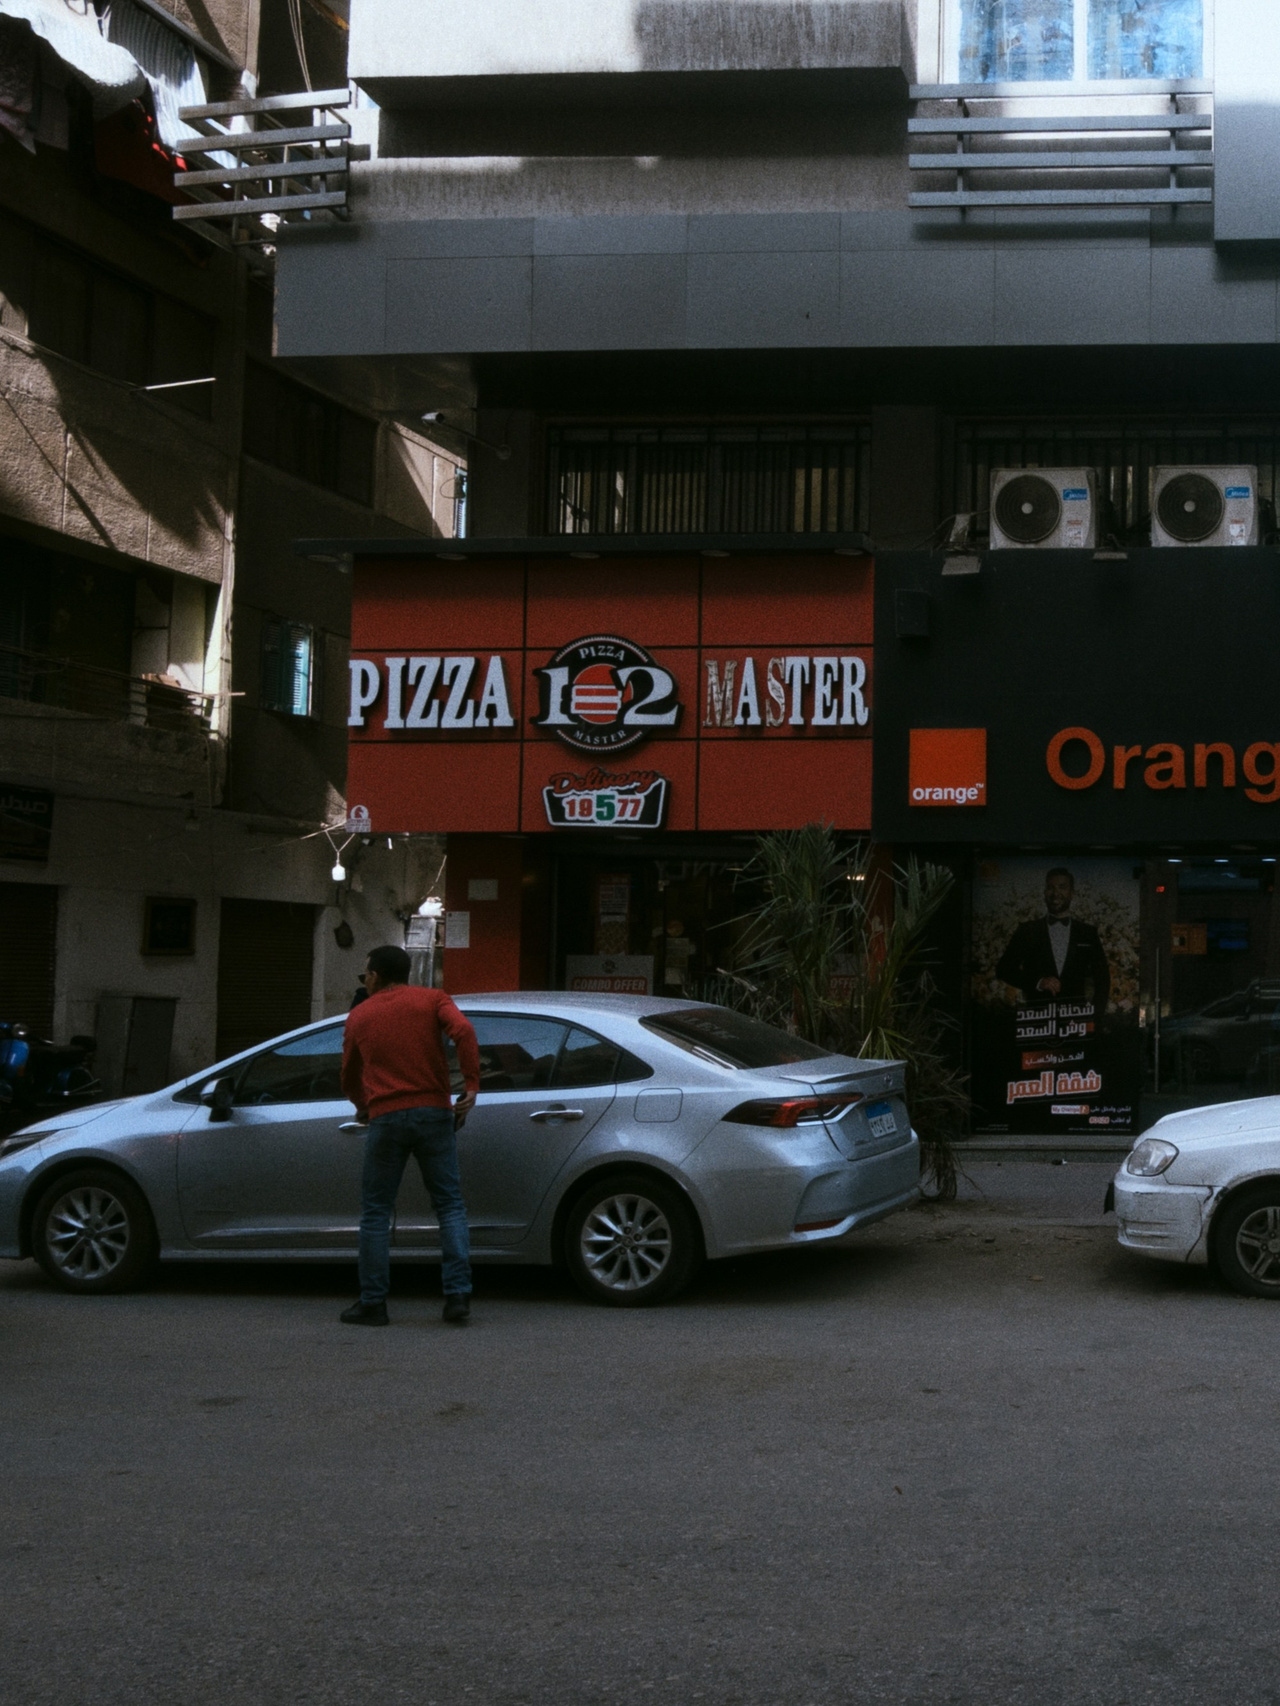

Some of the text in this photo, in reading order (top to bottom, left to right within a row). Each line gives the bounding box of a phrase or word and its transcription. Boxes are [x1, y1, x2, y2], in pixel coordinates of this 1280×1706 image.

[579, 645, 626, 661] PIZZA
[347, 655, 516, 729] PIZZA
[702, 655, 870, 729] MASTER
[573, 729, 627, 745] MASTER
[549, 766, 658, 794] Delivery
[564, 794, 643, 821] 19577
[573, 978, 646, 991] COMBO OFFER
[1016, 1002, 1095, 1021] شحنة السعد
[1016, 1020, 1087, 1038] وش السعد
[1006, 1069, 1102, 1105] شقة العمر
